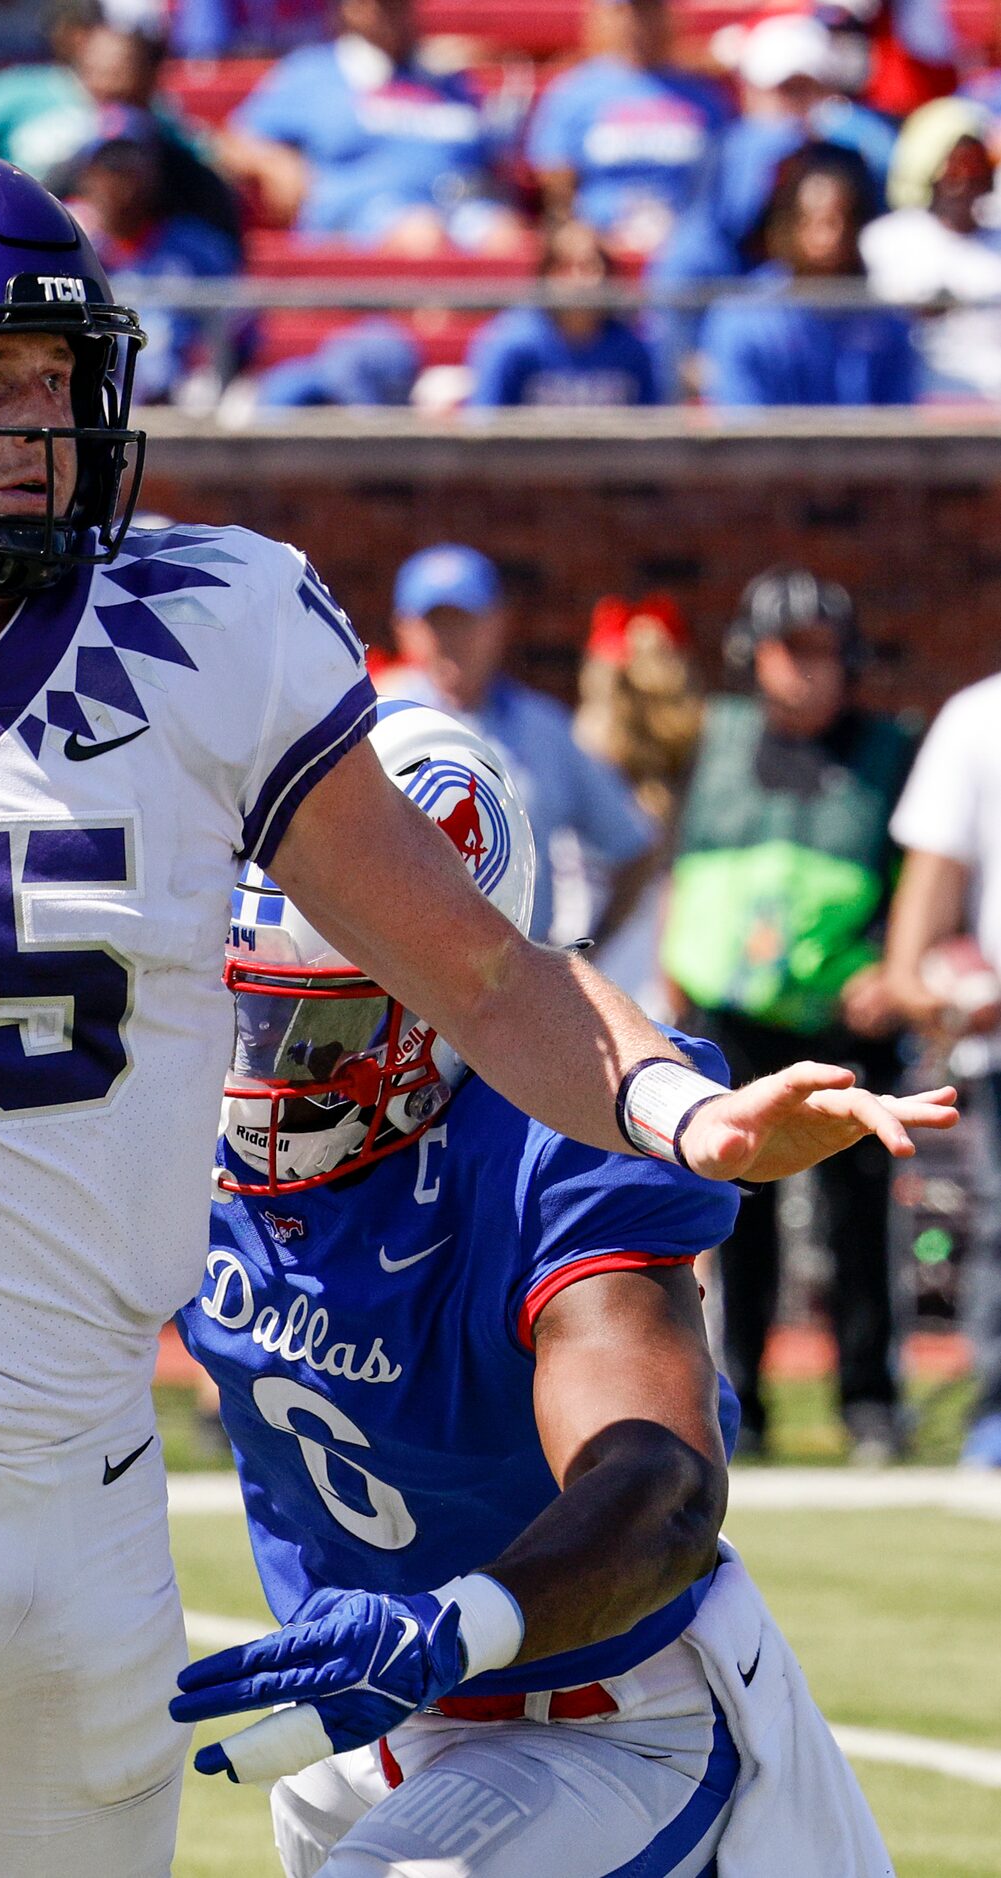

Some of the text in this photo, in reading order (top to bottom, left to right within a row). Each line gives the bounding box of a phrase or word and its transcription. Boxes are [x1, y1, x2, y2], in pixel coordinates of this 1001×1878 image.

[37, 276, 86, 302] TCU
[225, 925, 256, 952] 14
[236, 1125, 290, 1153] Riddll
[413, 1123, 447, 1205] C
[201, 1250, 402, 1383] Dallas
[252, 1376, 417, 1550] 6
